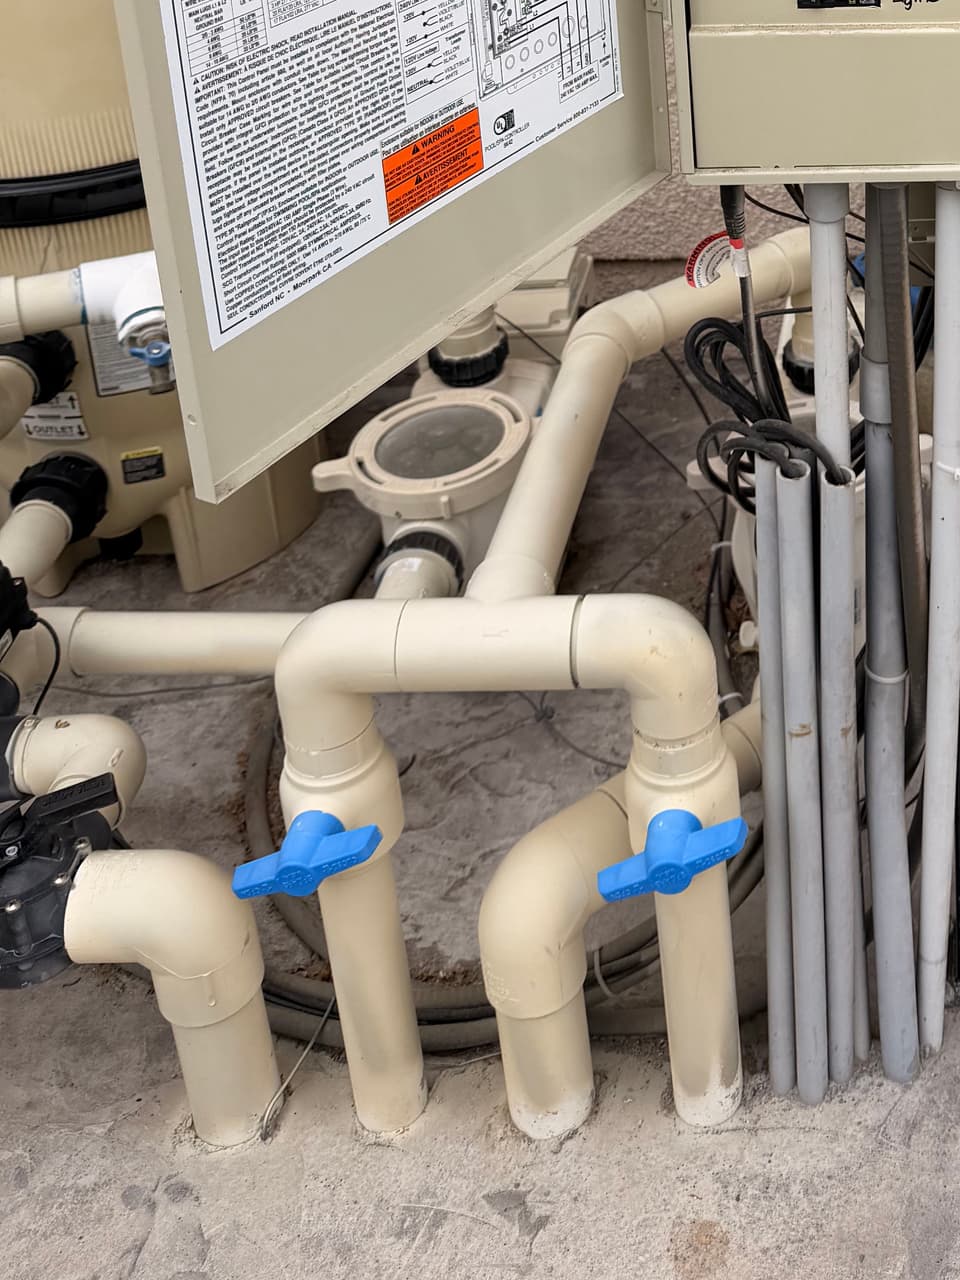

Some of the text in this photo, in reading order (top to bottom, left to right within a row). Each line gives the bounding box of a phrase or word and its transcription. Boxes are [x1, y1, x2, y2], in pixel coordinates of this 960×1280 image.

[421, 124, 455, 148] WARNING
[535, 126, 557, 142] Customer
[557, 117, 573, 130] Service
[423, 149, 468, 180] AVERTISSEMENT
[249, 263, 333, 319] Sanford NC Moorpark CA
[32, 425, 75, 434] OUTLET
